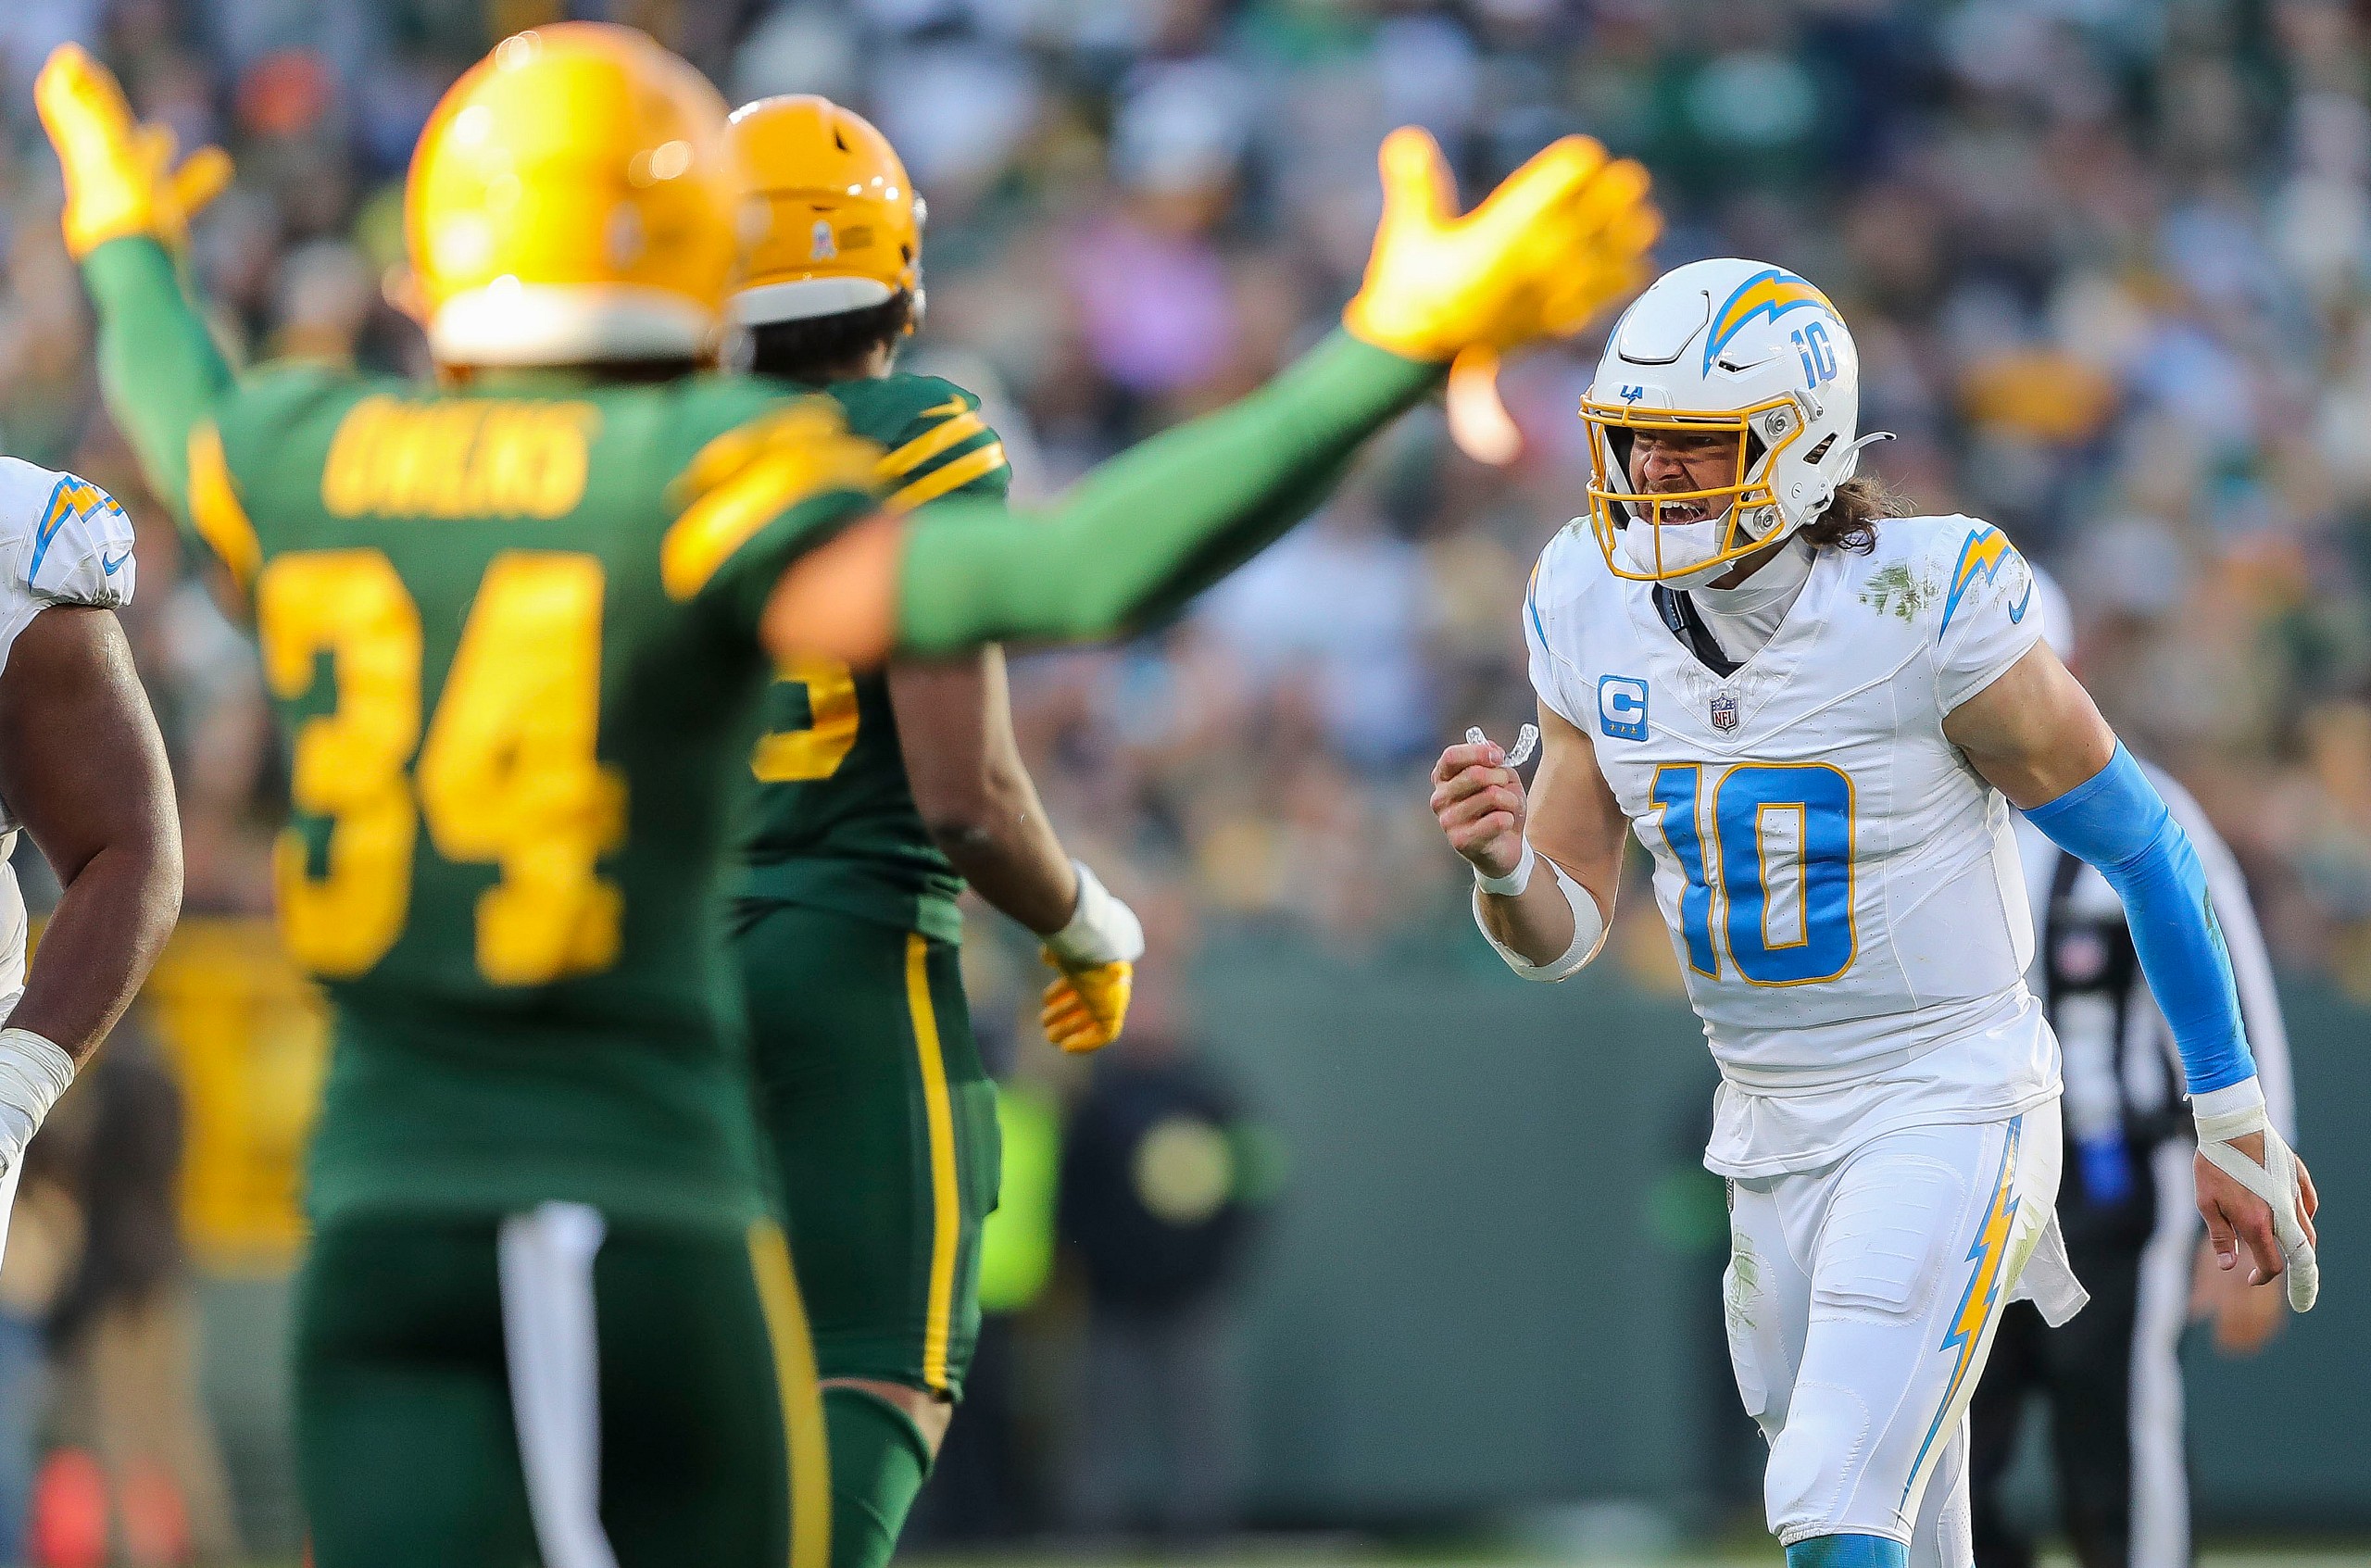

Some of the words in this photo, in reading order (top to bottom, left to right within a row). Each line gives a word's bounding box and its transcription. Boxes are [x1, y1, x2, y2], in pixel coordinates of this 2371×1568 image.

[1790, 321, 1838, 389] 10
[1620, 384, 1643, 405] LA
[1601, 680, 1643, 724] C
[1713, 710, 1735, 726] NFL
[258, 548, 630, 987] 34
[1649, 760, 1858, 988] 10
